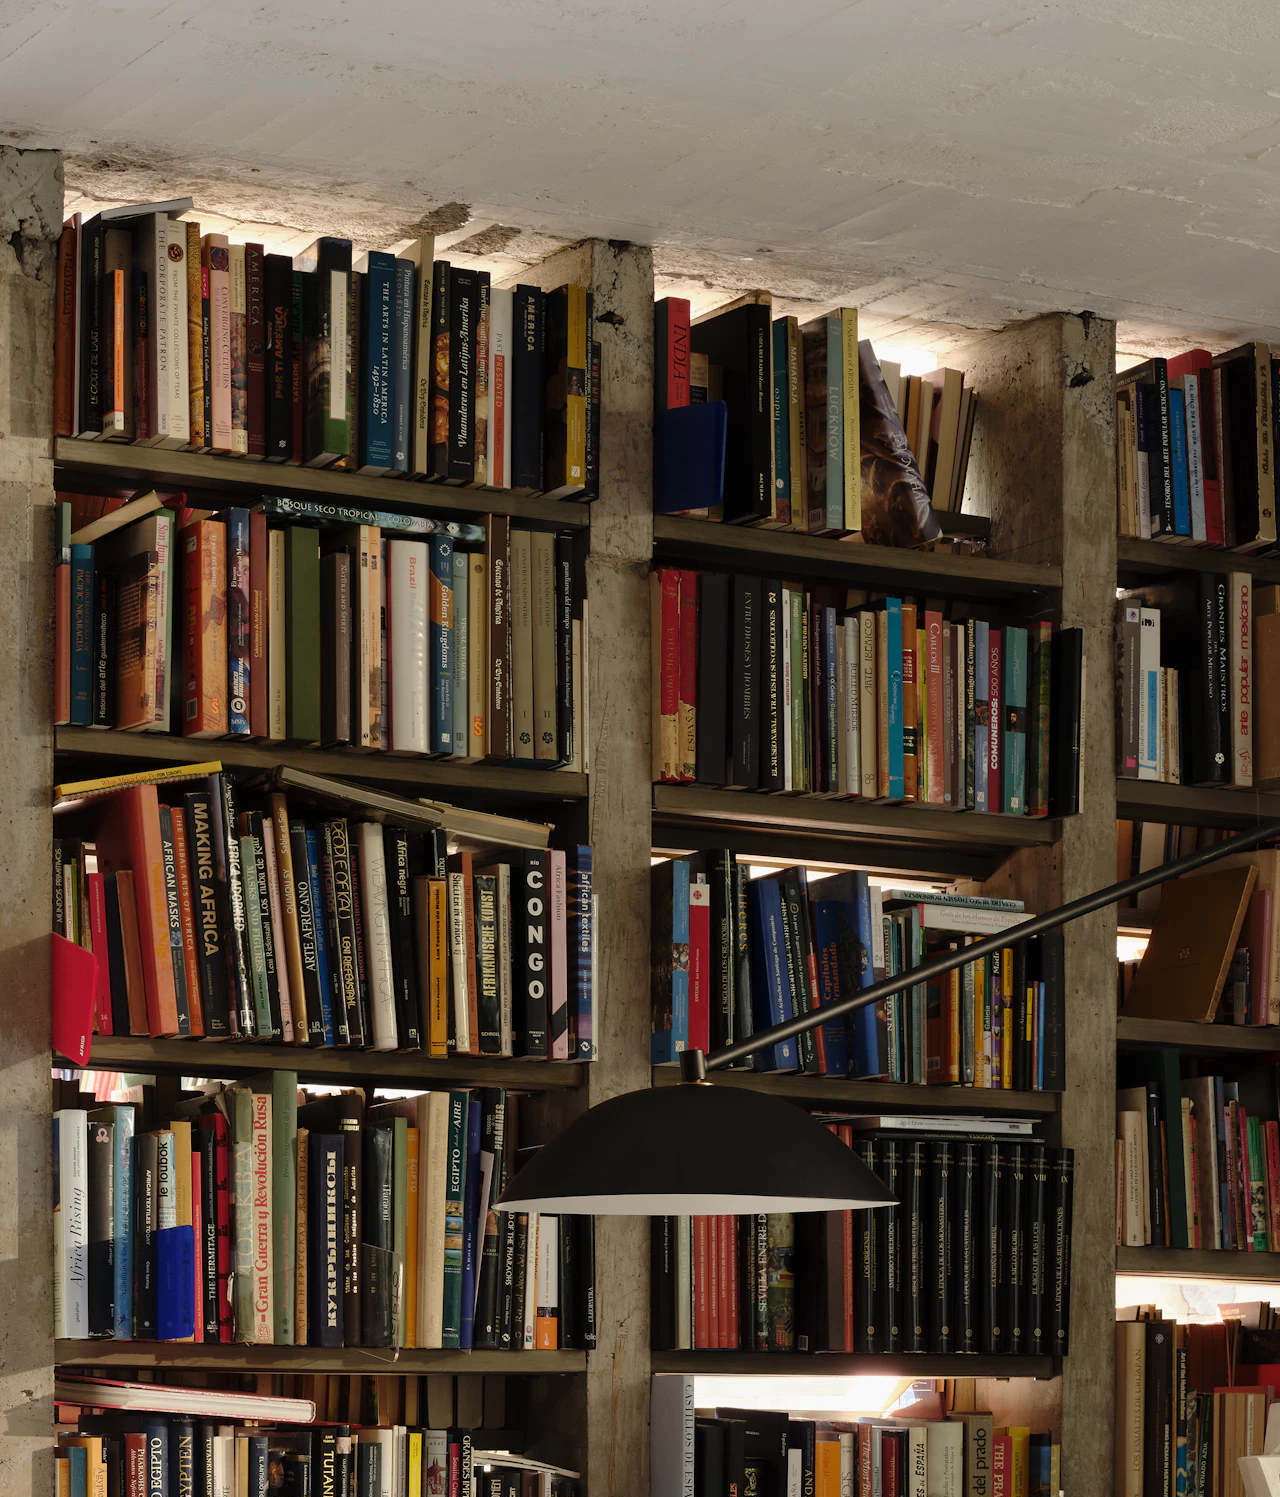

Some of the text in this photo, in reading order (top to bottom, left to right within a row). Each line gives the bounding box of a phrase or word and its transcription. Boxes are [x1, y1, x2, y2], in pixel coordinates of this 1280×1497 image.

[158, 229, 166, 250] THE
[380, 282, 390, 424] THE ARTS IN LATIN AMERICA
[526, 296, 535, 352] AMERICA
[673, 324, 687, 380] INDIA
[790, 346, 798, 404] MAHARAJA
[829, 386, 839, 461] LUCKNOW
[1160, 380, 1171, 508] TESOROS DEL ARTE POPULAR MEXICANO
[76, 568, 85, 652] PACIFIC NICARAGUA
[148, 562, 156, 632] LA BUENA VISTA
[440, 584, 450, 668] Golden Kingdoms
[864, 618, 873, 696] ARTE IBERICO
[1218, 584, 1226, 712] GRANDES MAESTROS
[1238, 585, 1250, 736] arte popular mexicano
[686, 707, 696, 752] ESPAÑA
[988, 647, 999, 770] COMUNEROS: 500 AÑOS
[162, 840, 180, 928] AFRICAN MASKS
[193, 802, 220, 957] MAKING AFRICA
[580, 874, 590, 952] african textiles
[904, 892, 942, 902] BORNEMISZA
[942, 894, 968, 902] THYSSEN
[970, 896, 990, 905] MUSEO
[297, 882, 315, 972] ARTE AFRICANO
[526, 870, 544, 1000] CONGO
[820, 946, 831, 1000] Capítulos
[158, 1142, 168, 1198] le loubok
[252, 1096, 270, 1313] Gran Guerra y Revolución Rusa
[69, 1186, 83, 1288] Africa Rising
[208, 1224, 216, 1300] THE HERMITAGE
[327, 1150, 338, 1328] КУКРЫНИКСЫ
[758, 1228, 768, 1312] SEVILLA ENTRE
[1134, 1348, 1142, 1394] URUAPAN
[1134, 1396, 1141, 1408] DE
[151, 1438, 163, 1490] EGIPTO
[462, 1435, 470, 1479] GRANDES
[912, 1444, 925, 1476] ESPAÑA
[973, 1474, 985, 1496] del
[974, 1428, 988, 1470] prado
[993, 1444, 1004, 1470] THE
